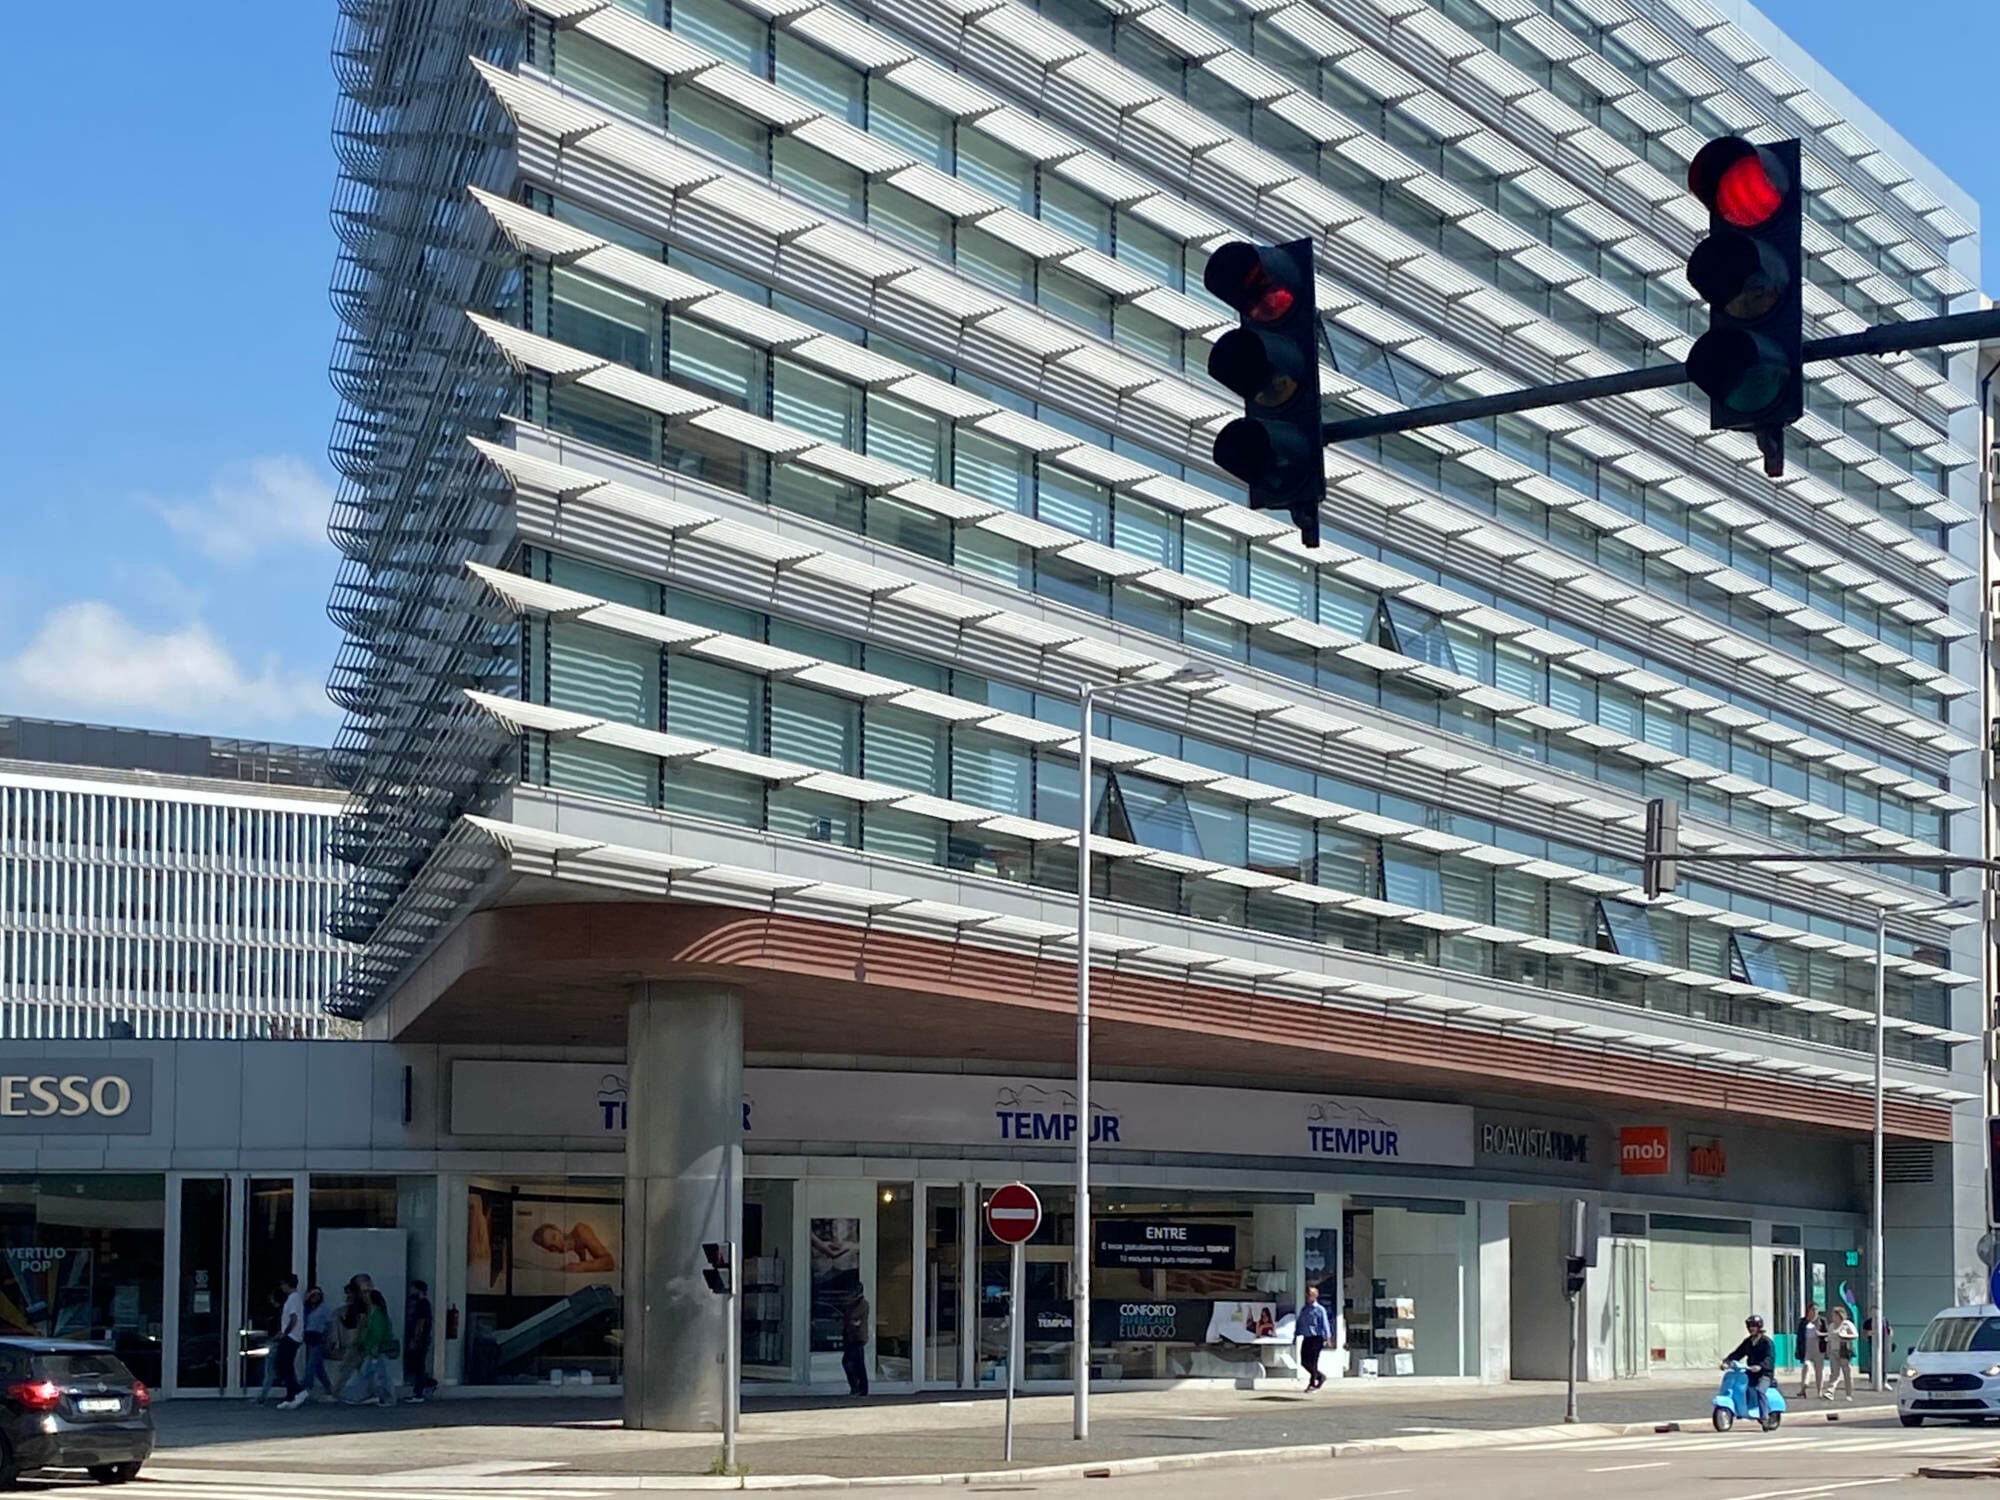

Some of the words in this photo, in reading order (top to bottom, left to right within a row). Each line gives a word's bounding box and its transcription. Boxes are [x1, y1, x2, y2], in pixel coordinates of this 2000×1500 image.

[0, 1075, 131, 1116] ESSO
[996, 1111, 1121, 1142] TEMPUR
[1307, 1126, 1399, 1156] TEMPUR
[1623, 1139, 1665, 1159] mob
[1145, 1226, 1187, 1240] ENTRE
[6, 1247, 66, 1259] VERTUO
[21, 1260, 51, 1272] POP
[1120, 1304, 1176, 1317] CONFORTO
